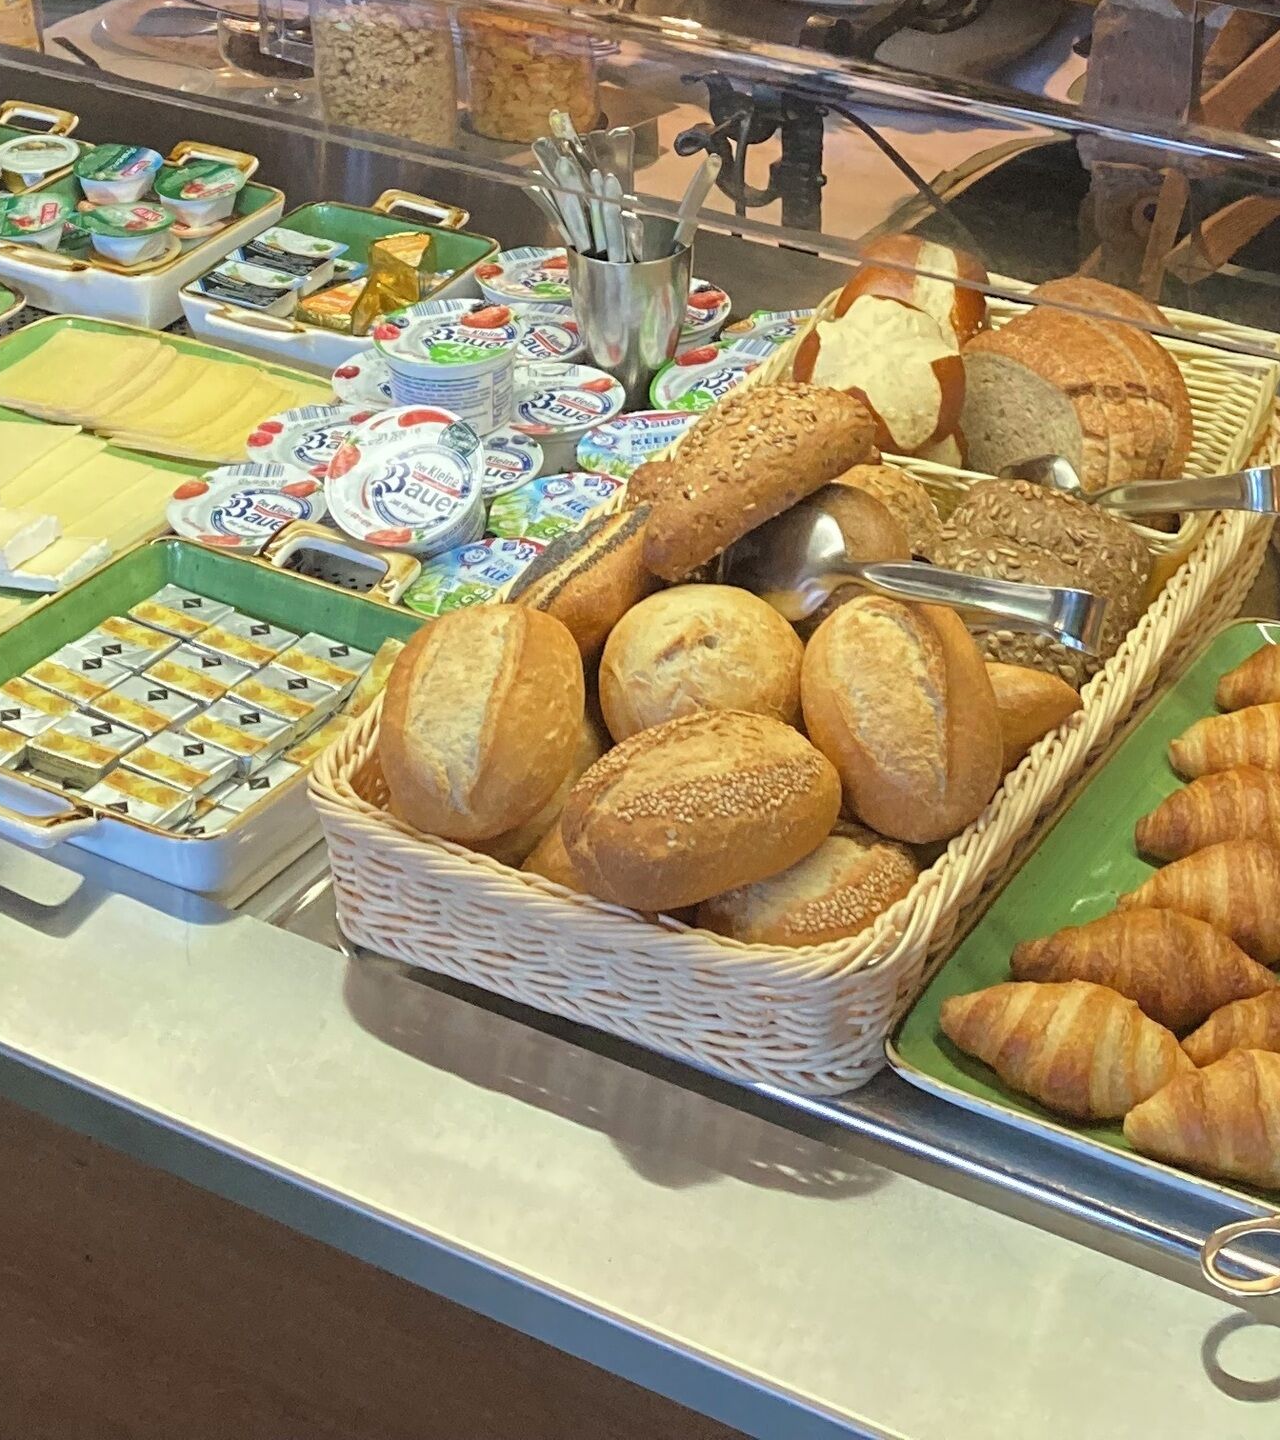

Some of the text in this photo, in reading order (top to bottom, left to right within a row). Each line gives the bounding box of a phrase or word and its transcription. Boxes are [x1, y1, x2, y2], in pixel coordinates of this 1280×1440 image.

[371, 462, 465, 516] Bauer
[428, 464, 460, 487] Kleine
[214, 496, 288, 532] Baue
